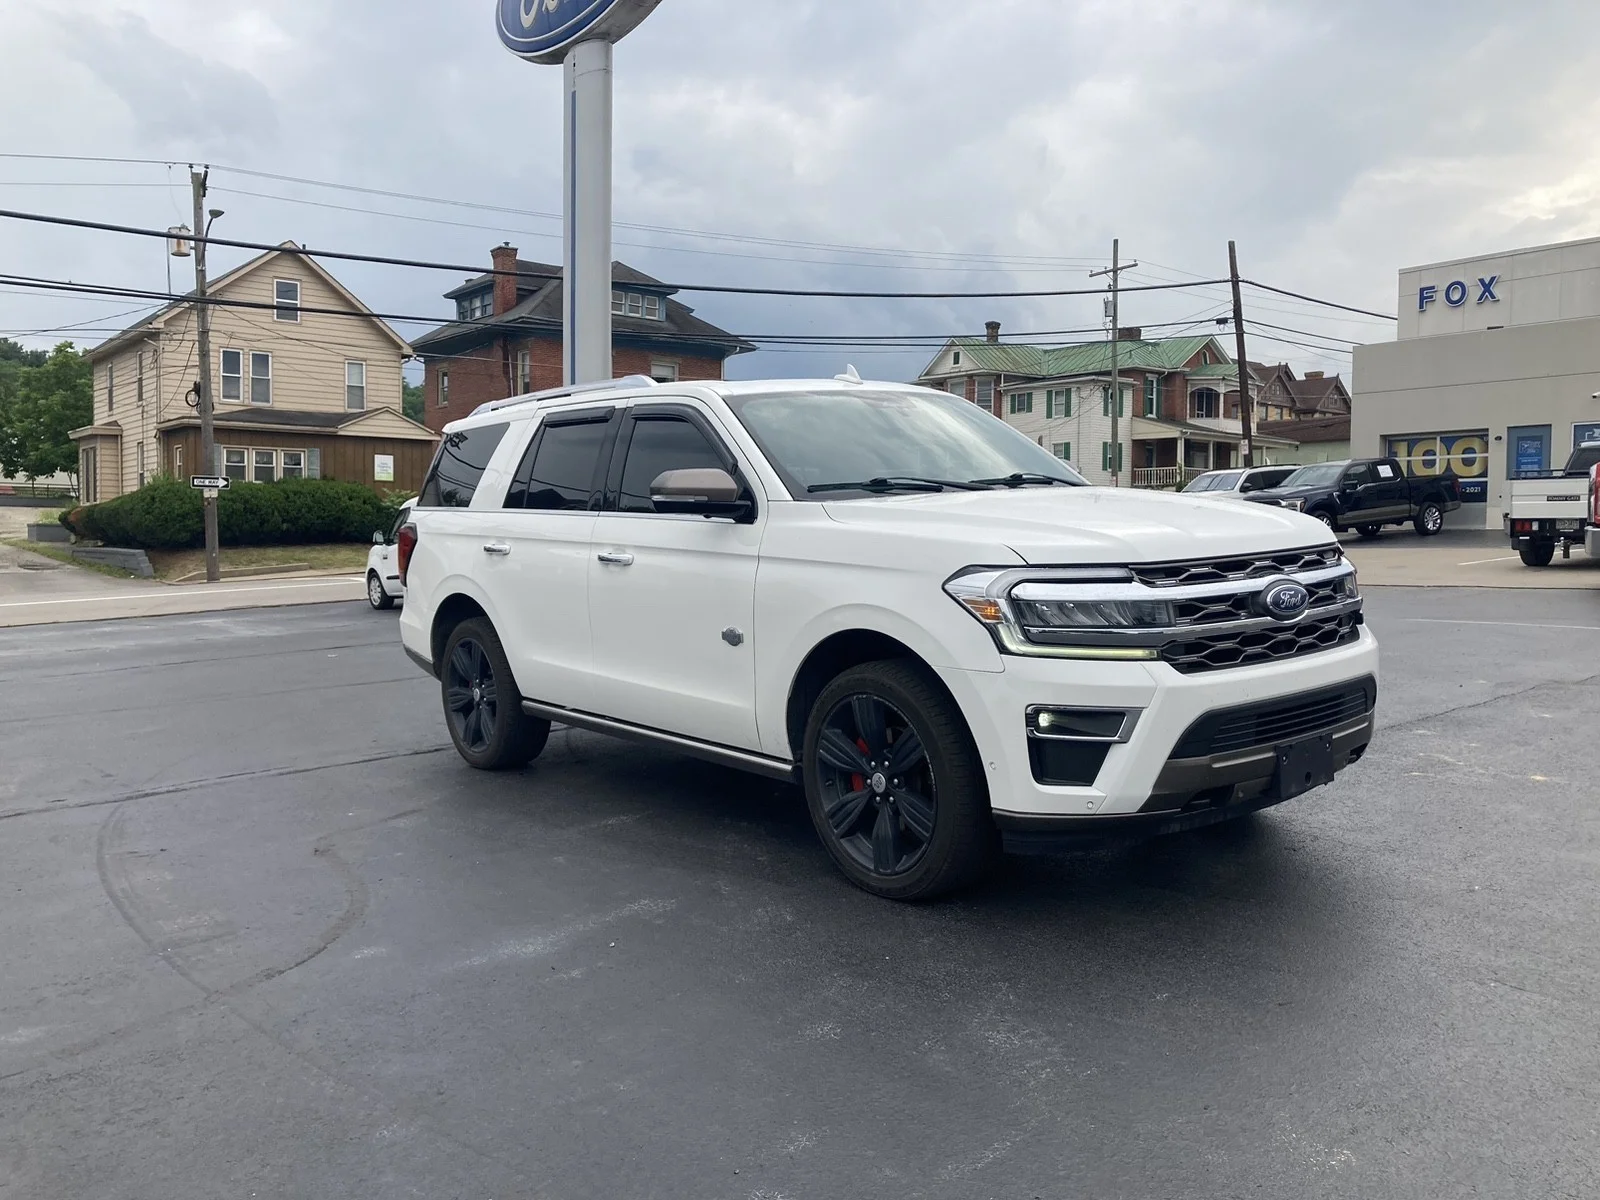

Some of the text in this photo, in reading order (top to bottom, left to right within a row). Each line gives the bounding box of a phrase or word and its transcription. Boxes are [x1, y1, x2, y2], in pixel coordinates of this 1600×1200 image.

[1418, 275, 1499, 311] FOX
[1391, 437, 1488, 477] 100
[1280, 591, 1301, 607] Ford
